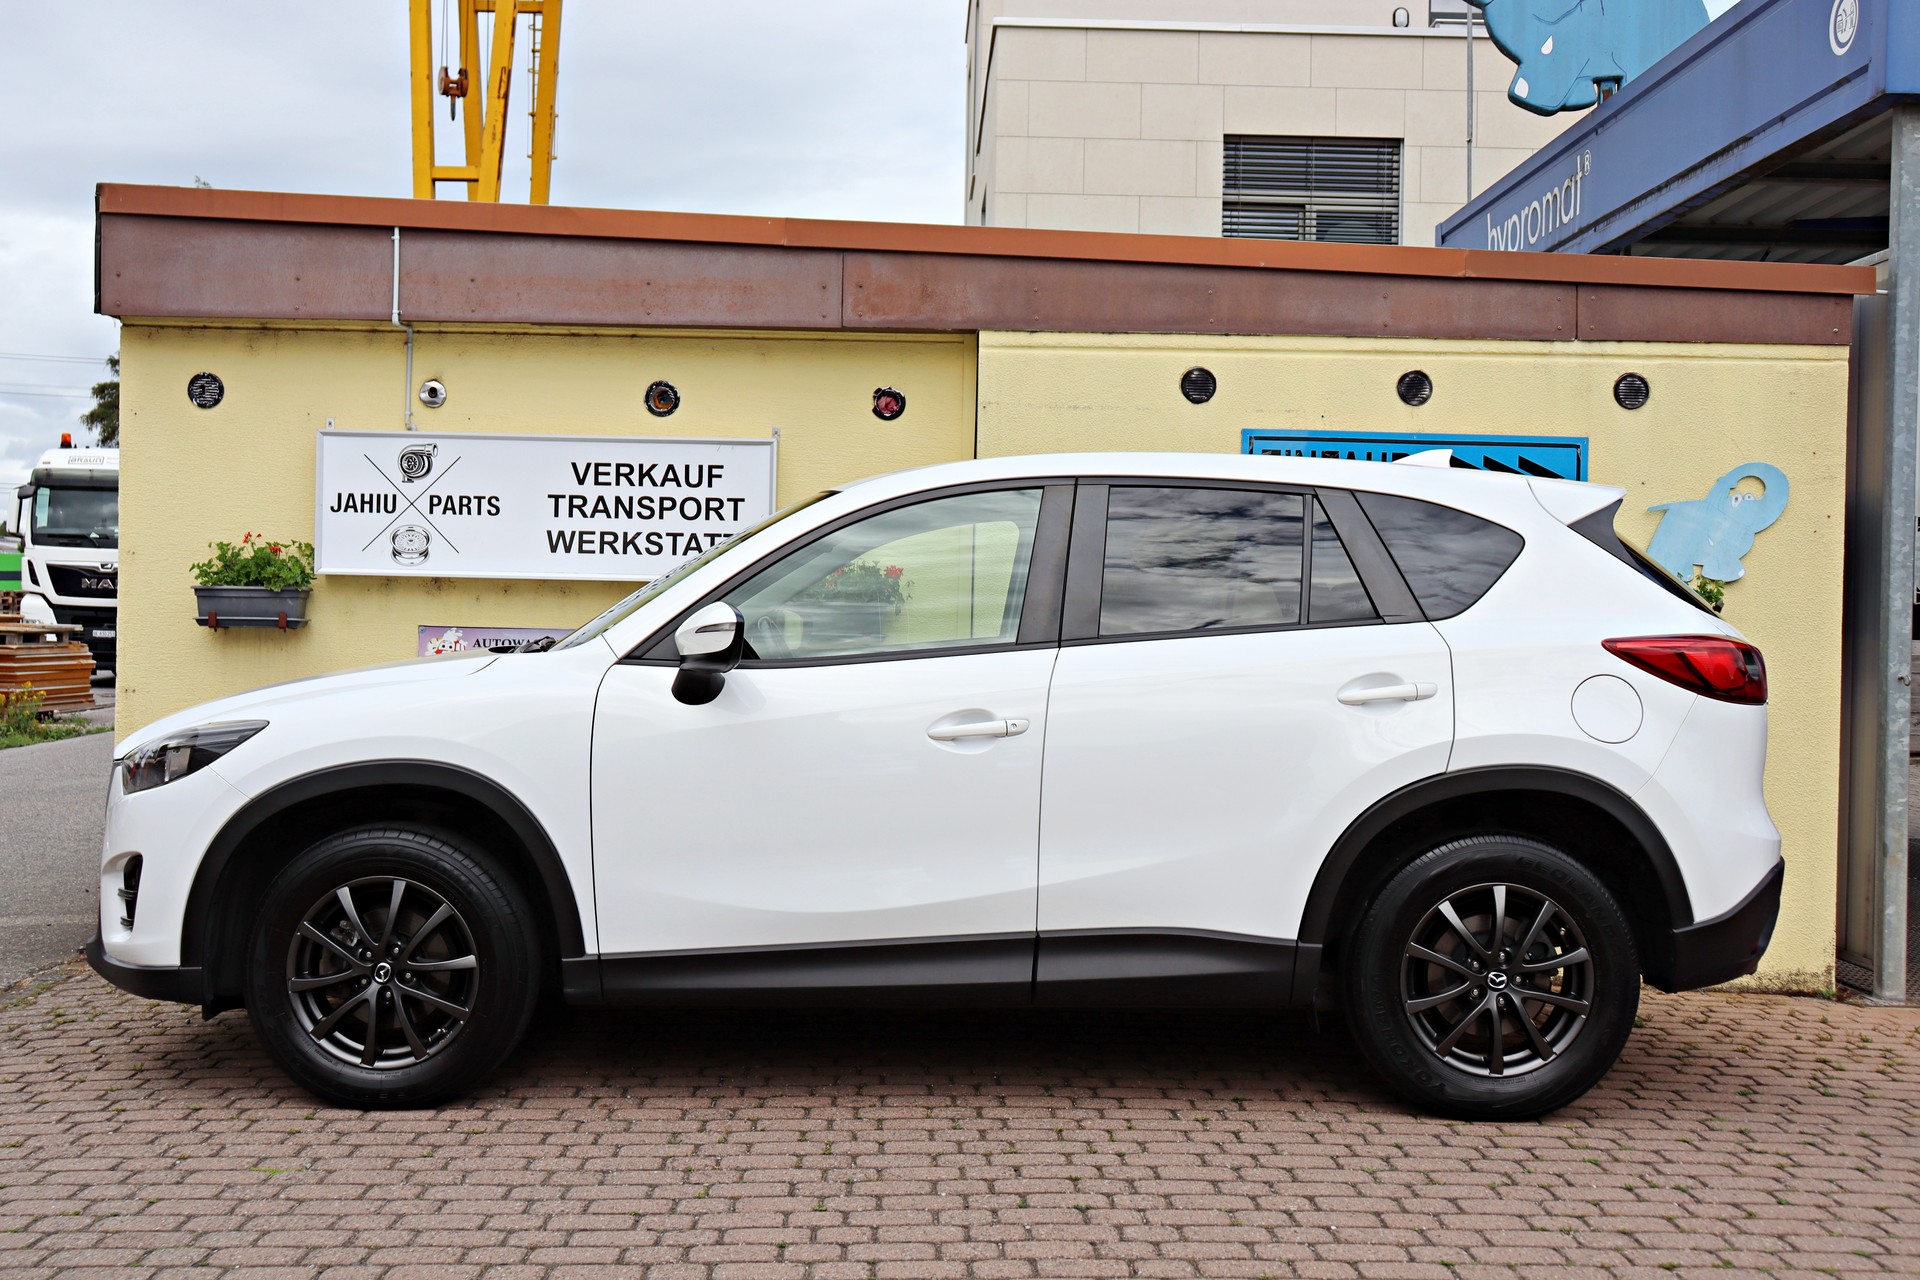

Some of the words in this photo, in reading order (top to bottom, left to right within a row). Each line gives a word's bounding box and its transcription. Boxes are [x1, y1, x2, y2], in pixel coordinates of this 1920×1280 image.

[571, 462, 724, 488] VERKAUF
[330, 492, 397, 514] JAHIU
[428, 494, 501, 517] PARTS
[548, 495, 746, 522] TRANSPORT
[81, 578, 118, 590] MA
